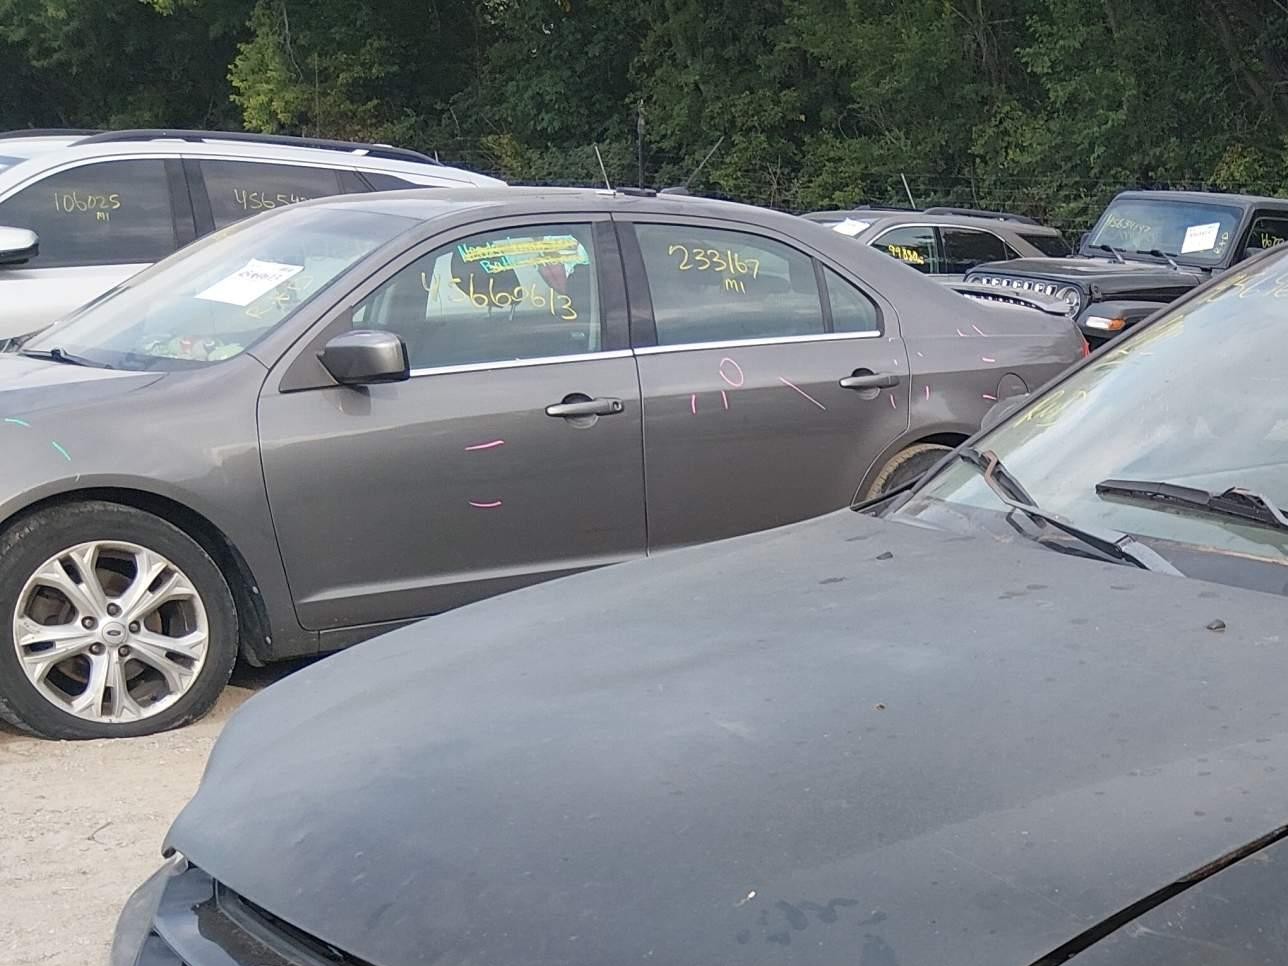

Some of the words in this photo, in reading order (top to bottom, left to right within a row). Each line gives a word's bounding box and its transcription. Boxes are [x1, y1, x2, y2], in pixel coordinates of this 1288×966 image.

[54, 191, 121, 213] 106025
[233, 188, 306, 210] 45654
[668, 244, 760, 280] 233167
